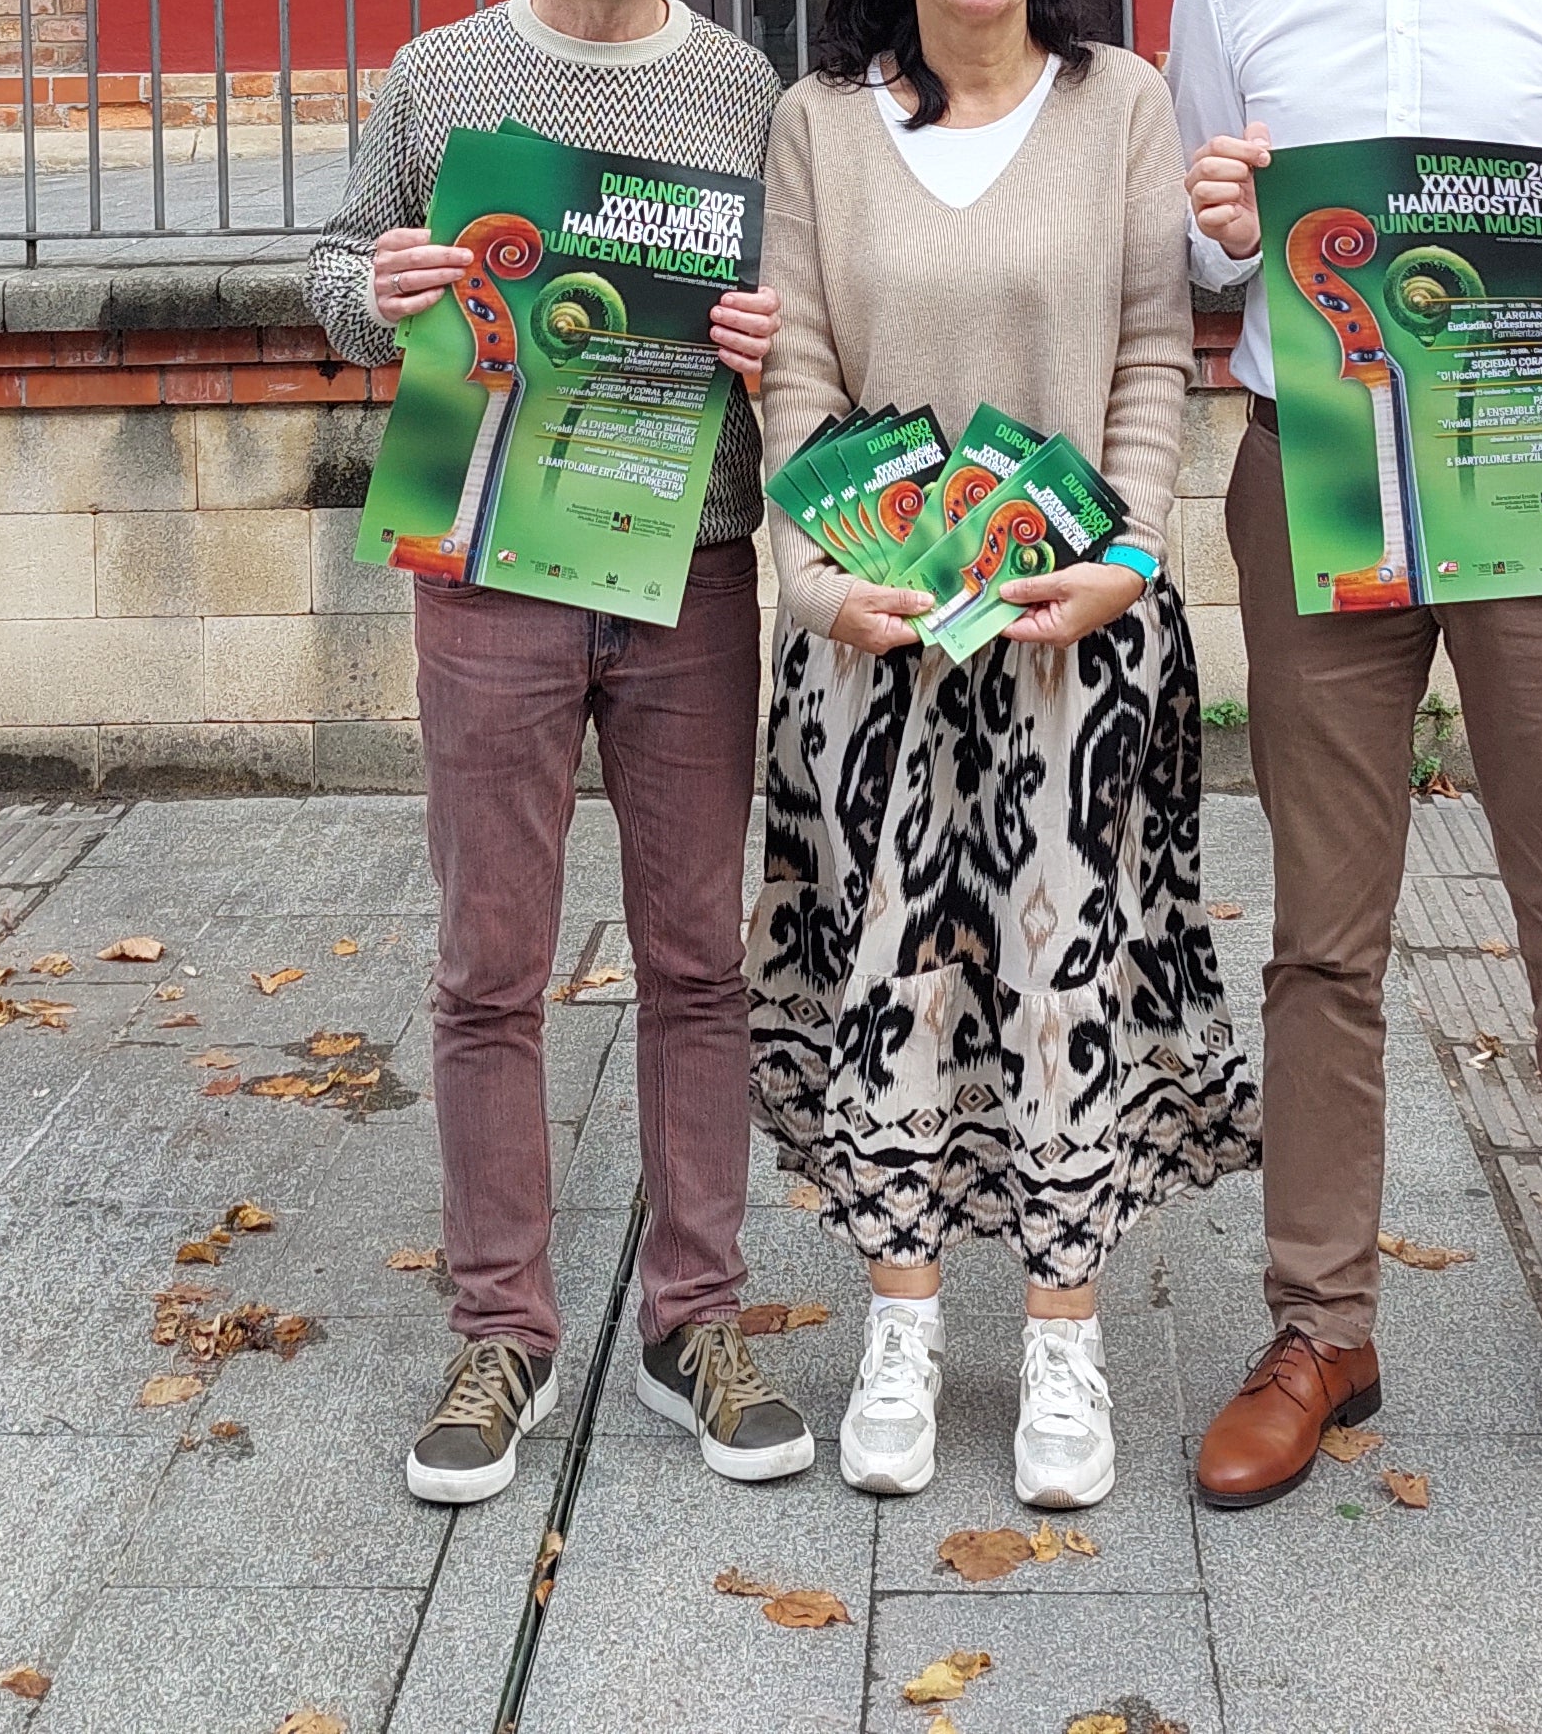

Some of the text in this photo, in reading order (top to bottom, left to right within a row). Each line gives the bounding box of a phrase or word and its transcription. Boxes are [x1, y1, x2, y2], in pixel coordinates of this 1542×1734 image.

[1419, 174, 1489, 195] XXXVI
[562, 210, 741, 260] HAMABOSTALDIA
[599, 194, 743, 239] XXXVI MUSIKA
[646, 247, 739, 281] MUSICAL
[866, 417, 930, 455] DURANGO
[995, 424, 1042, 455] DURAN
[863, 452, 945, 495] HAMABOSTALDIA
[1062, 472, 1113, 532] DURANGO
